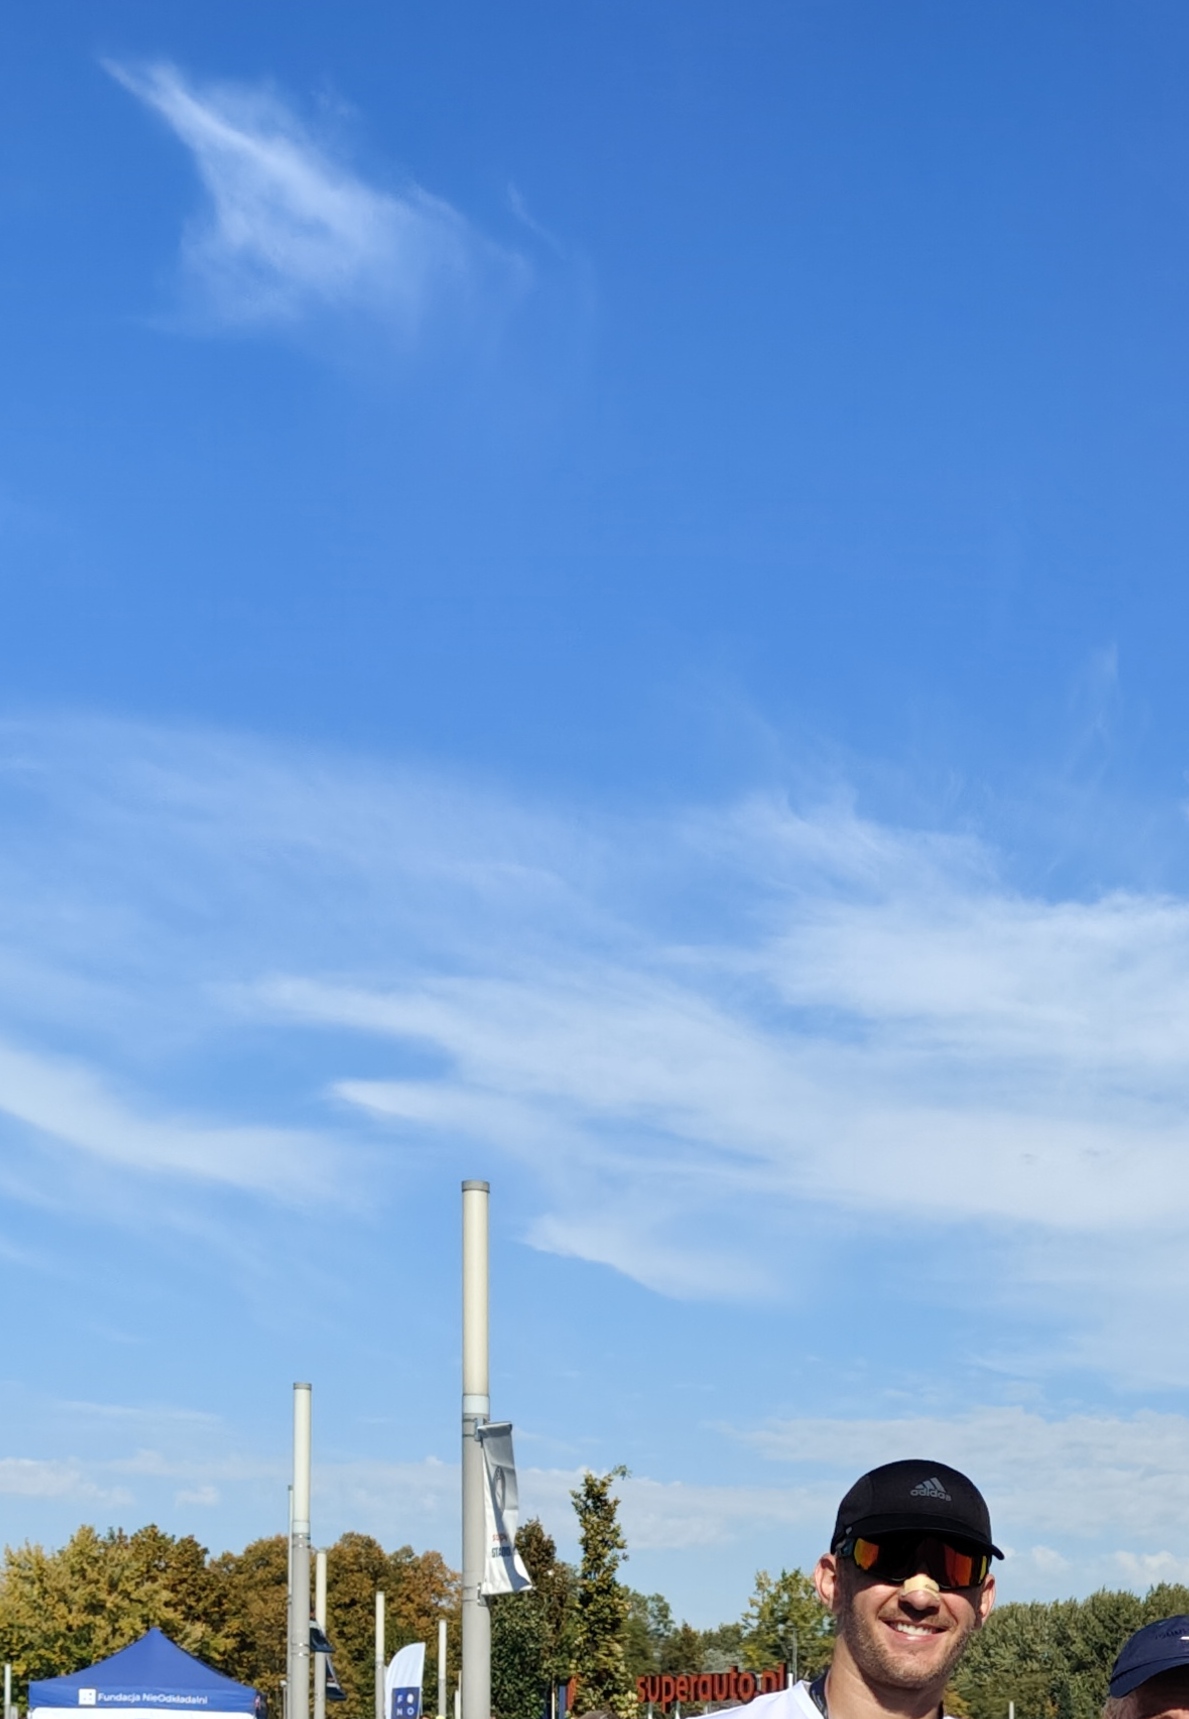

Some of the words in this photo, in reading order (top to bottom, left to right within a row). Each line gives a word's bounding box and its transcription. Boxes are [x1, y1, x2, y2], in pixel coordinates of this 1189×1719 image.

[910, 1488, 952, 1501] adidas
[636, 1663, 788, 1713] superauto.pl
[98, 1692, 141, 1703] Fundacja
